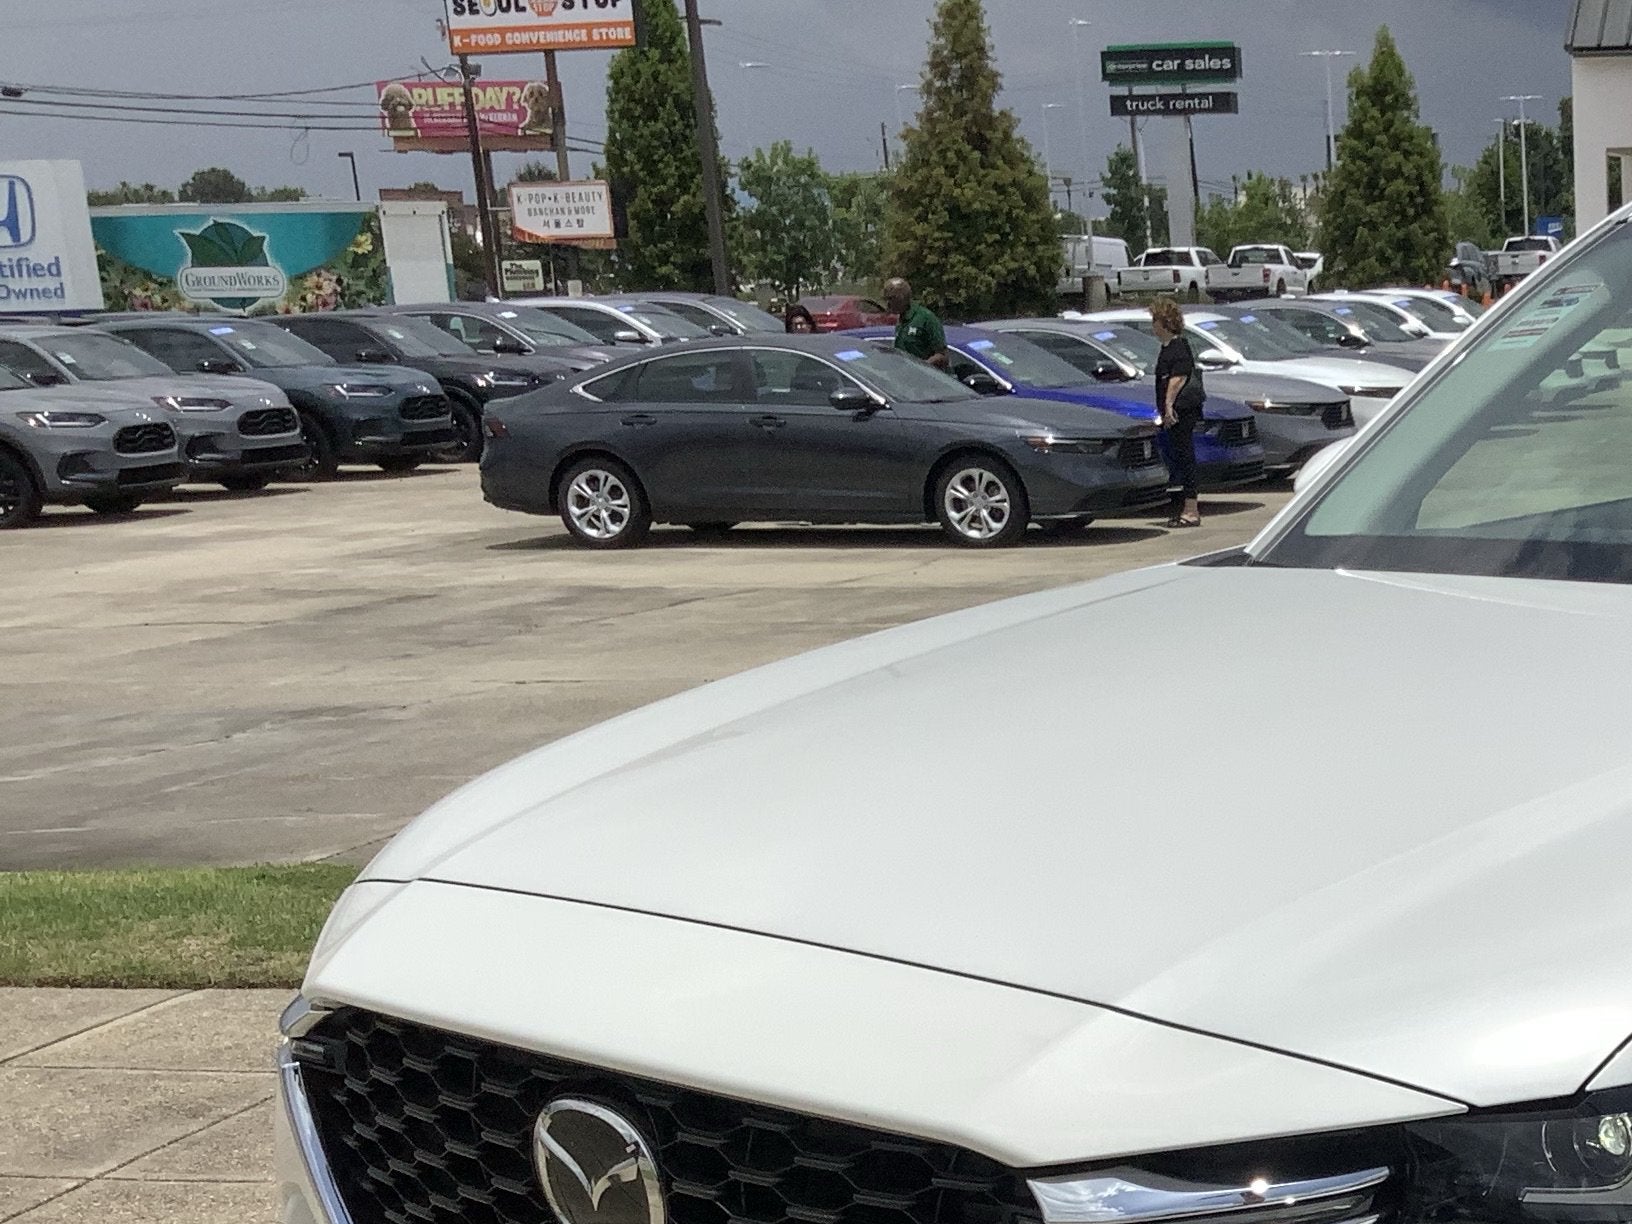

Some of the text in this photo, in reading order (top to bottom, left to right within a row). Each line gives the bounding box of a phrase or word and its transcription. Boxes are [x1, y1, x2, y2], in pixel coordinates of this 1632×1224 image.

[453, 27, 632, 47] K-FOOD CONVENIENCE STORE
[1152, 59, 1180, 71] car
[1185, 54, 1232, 70] sales
[1126, 95, 1213, 111] truck rental
